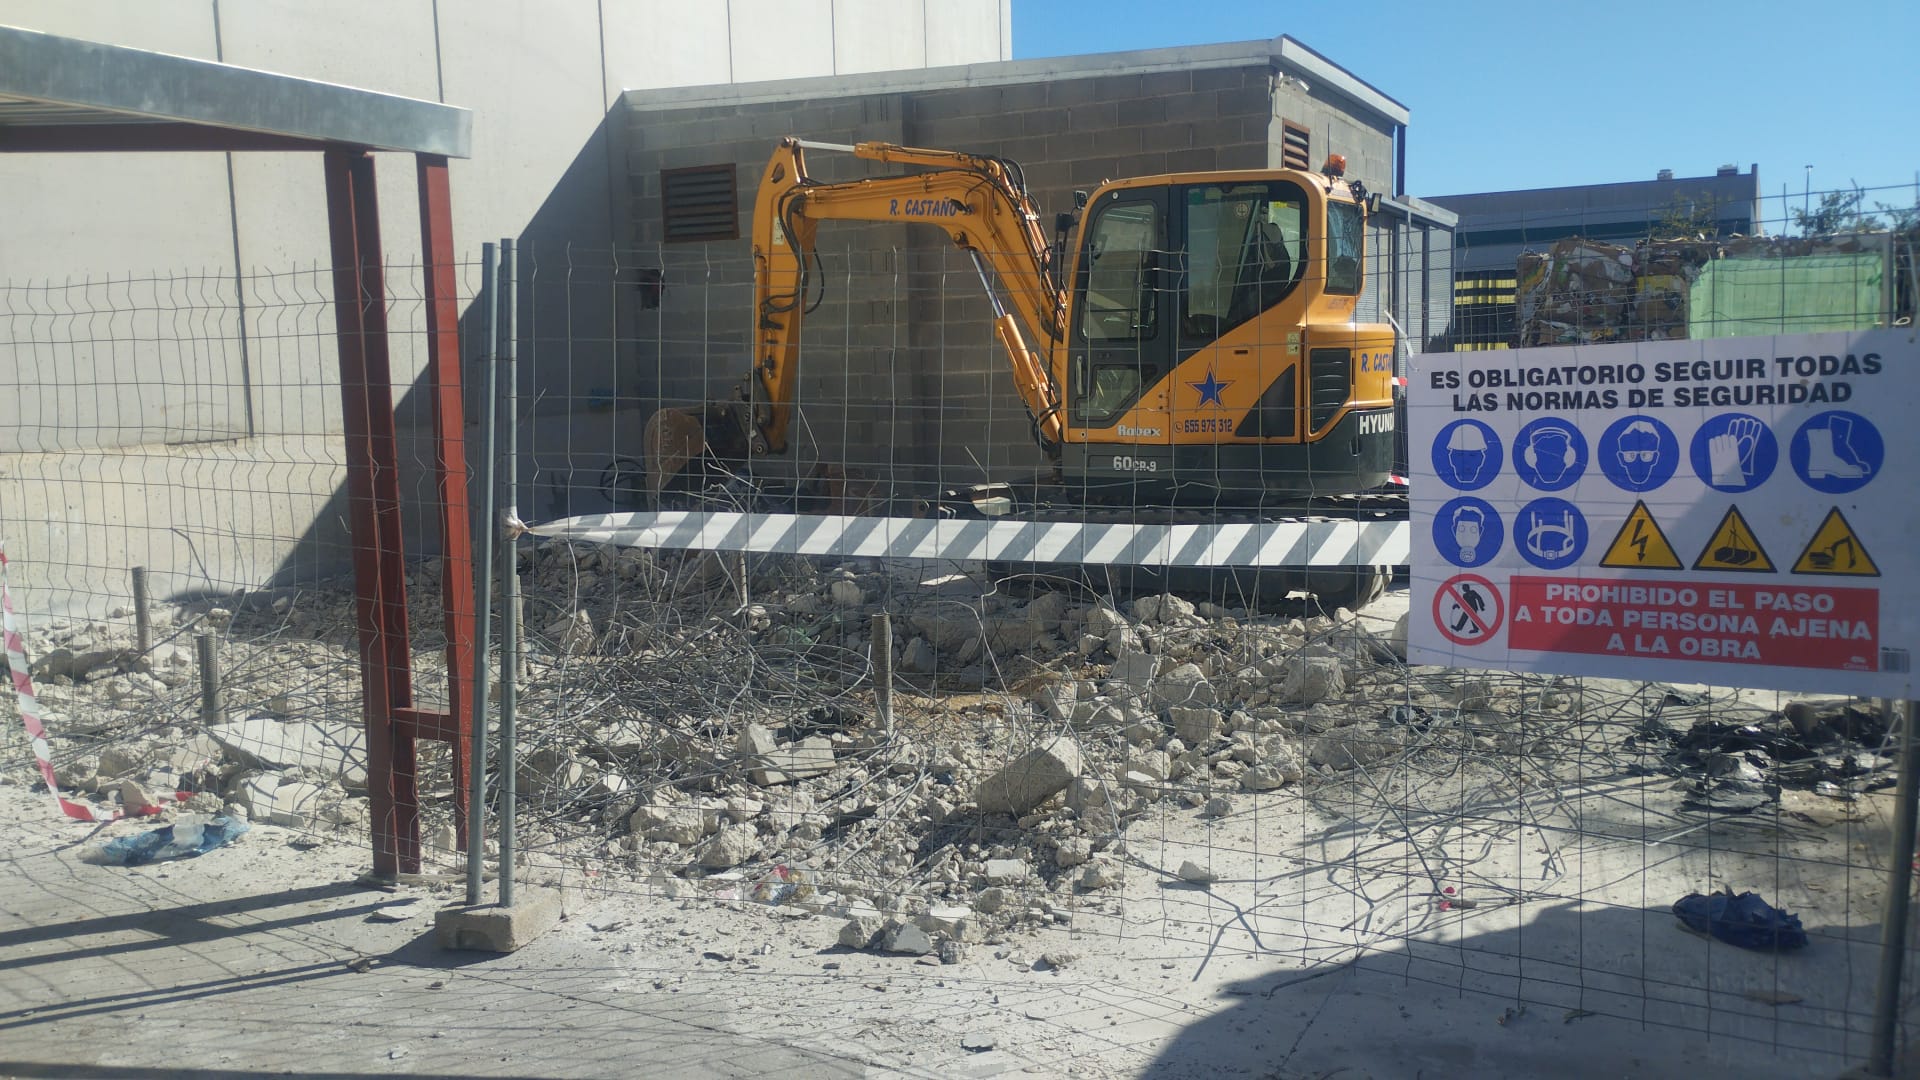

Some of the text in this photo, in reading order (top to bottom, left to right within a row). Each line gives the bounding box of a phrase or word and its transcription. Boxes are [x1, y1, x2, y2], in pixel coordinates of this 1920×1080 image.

[889, 198, 900, 216] R.
[1361, 353, 1370, 373] R.
[1430, 352, 1882, 389] ES OBLIGATORIO SEGUIR TODAS
[1453, 381, 1853, 412] LAS NORMAS DE SEGURIDAD
[1184, 420, 1199, 433] 655
[1218, 418, 1233, 433] 312
[1546, 583, 1835, 613] PROHIBIDO EL PASO
[1515, 605, 1872, 640] A TODA PERSONA AJENA
[1606, 633, 1761, 659] A LA OBRA
